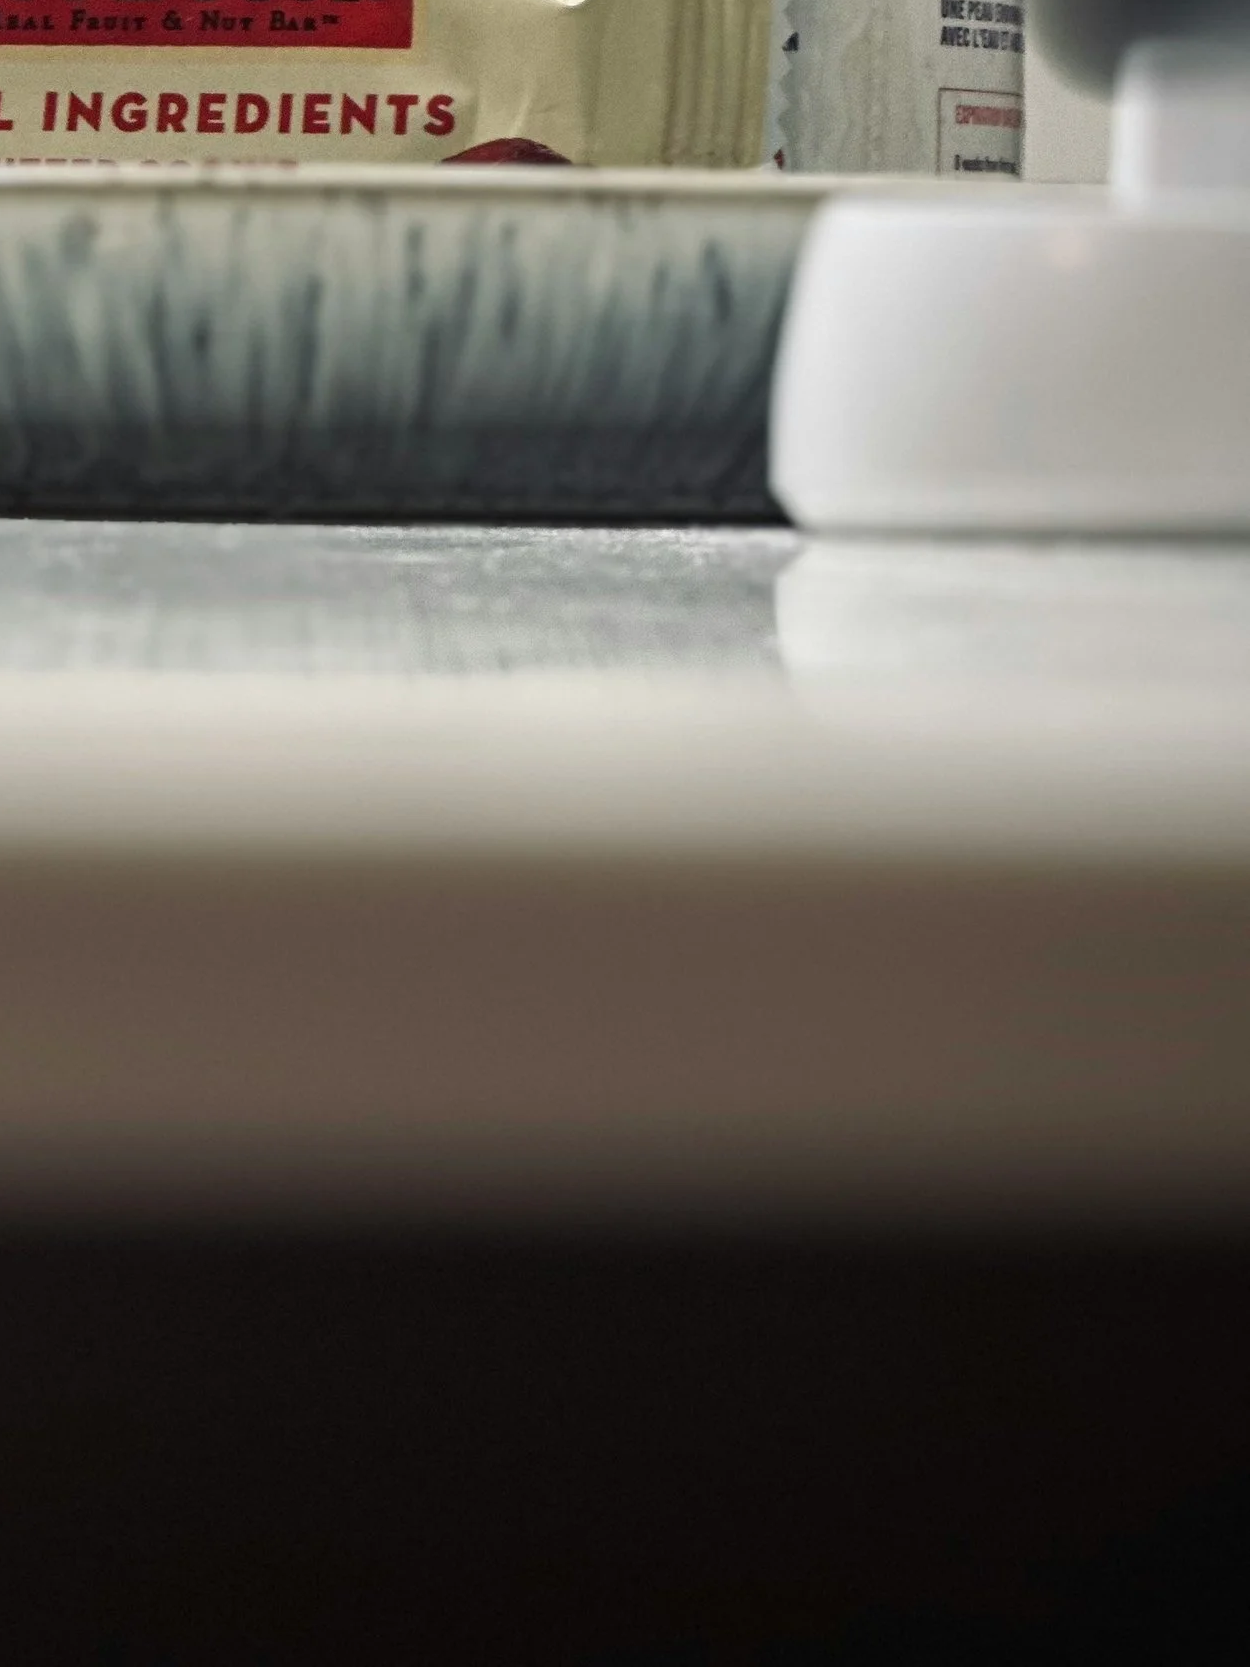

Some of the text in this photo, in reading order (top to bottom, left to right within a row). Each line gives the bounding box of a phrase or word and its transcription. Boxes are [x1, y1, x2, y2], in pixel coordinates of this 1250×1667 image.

[162, 9, 183, 32] &
[941, 26, 970, 47] AVEC
[42, 90, 457, 137] INGREDIENTS
